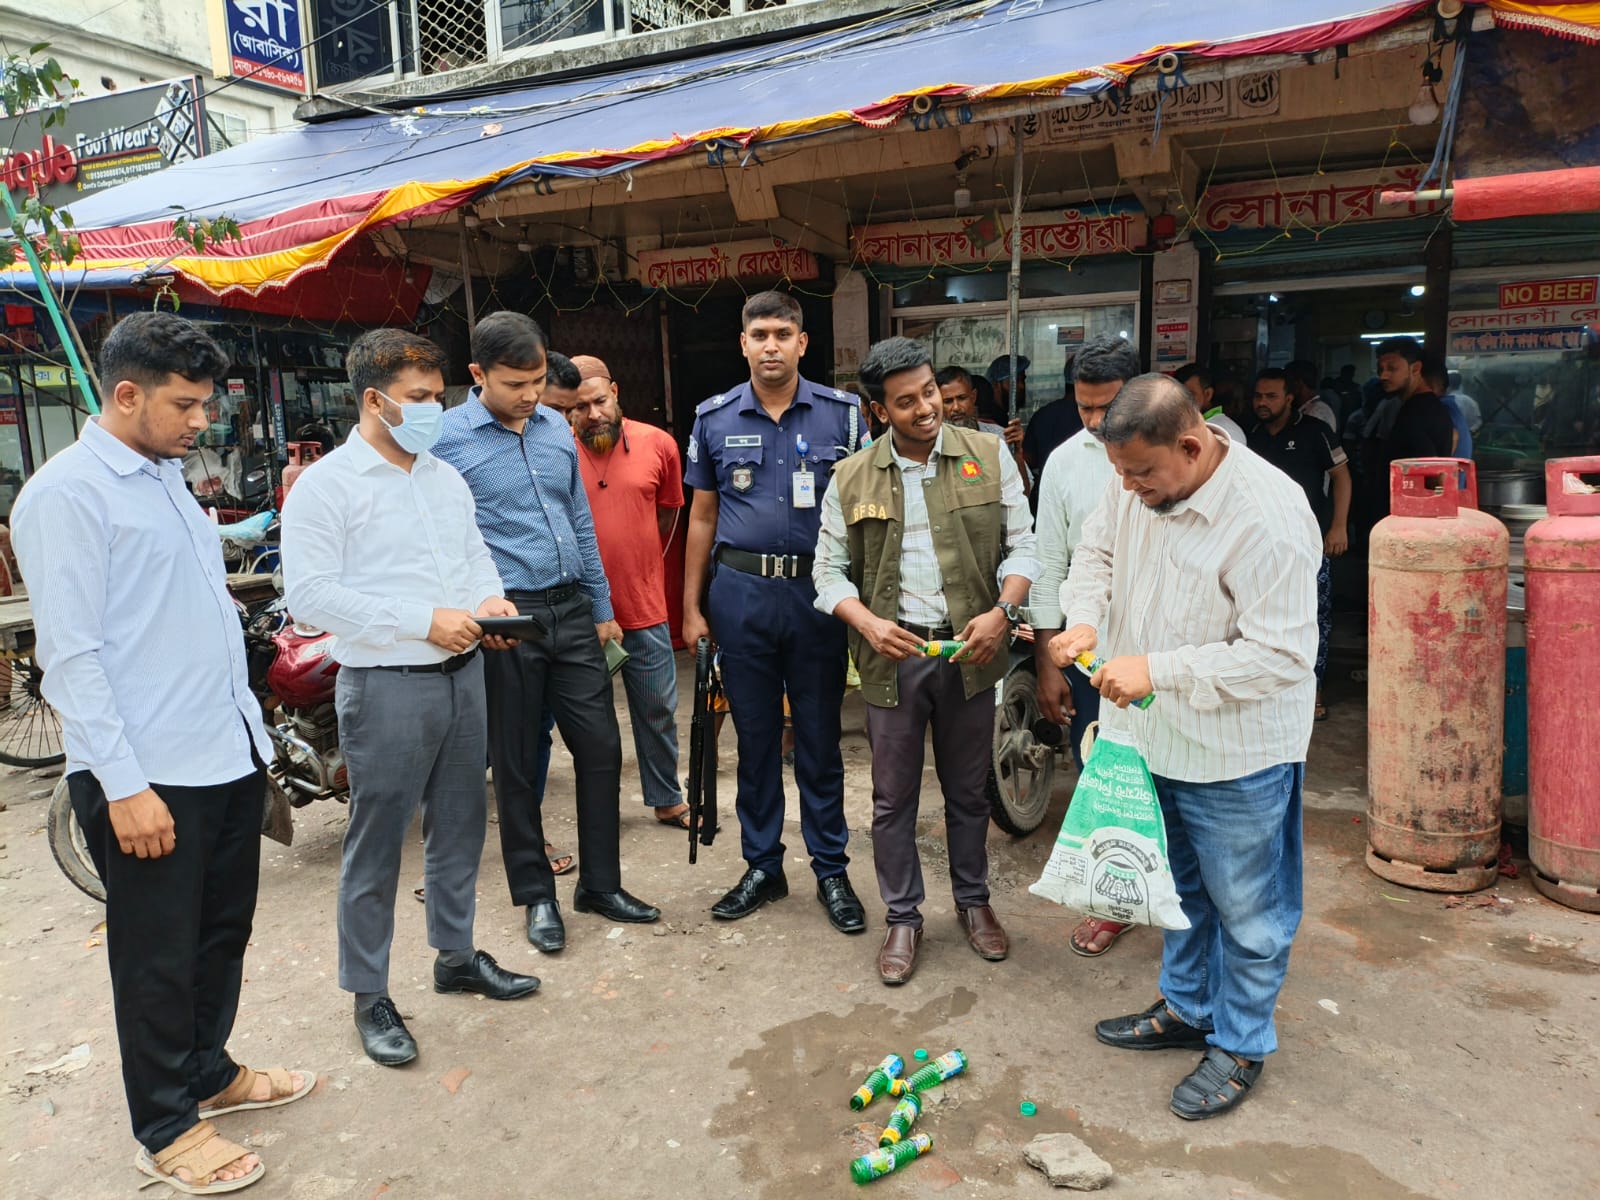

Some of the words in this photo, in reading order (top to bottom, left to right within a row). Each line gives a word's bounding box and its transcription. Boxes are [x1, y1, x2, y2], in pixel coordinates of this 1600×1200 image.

[76, 131, 107, 158] Foot
[109, 122, 160, 151] Wear's
[1504, 286, 1533, 304] NO
[1539, 282, 1592, 301] BEEF
[1449, 308, 1560, 329] সোনারগাঁ
[854, 504, 886, 521] BFSA
